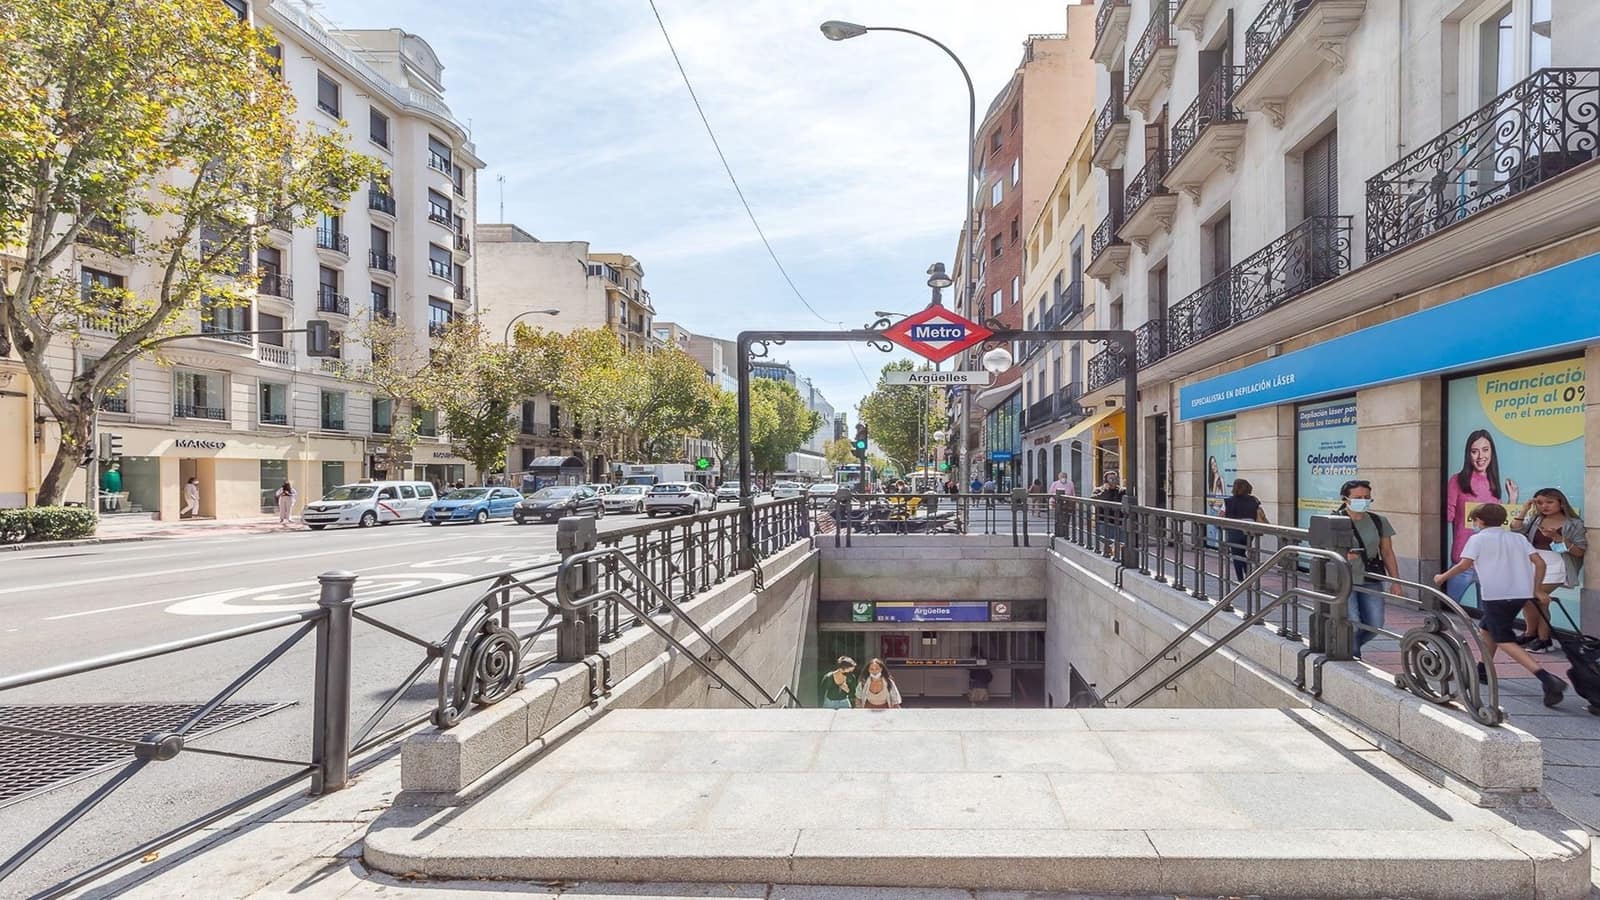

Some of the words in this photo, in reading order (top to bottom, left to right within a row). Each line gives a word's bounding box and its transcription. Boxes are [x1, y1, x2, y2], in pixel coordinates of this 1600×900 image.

[916, 326, 962, 338] Metro
[908, 373, 968, 383] Argüelles
[1486, 367, 1585, 394] Financiació
[1191, 392, 1225, 407] ESPECIALISTAS
[1225, 390, 1234, 399] EN
[1234, 379, 1271, 397] DEPILACIÓN
[1273, 373, 1296, 387] LÁSER
[1495, 392, 1539, 411] propia
[1543, 389, 1558, 403] al
[1504, 411, 1518, 419] en
[1521, 408, 1531, 417] el
[175, 439, 226, 449] MANGO
[914, 607, 950, 615] Argüelles
